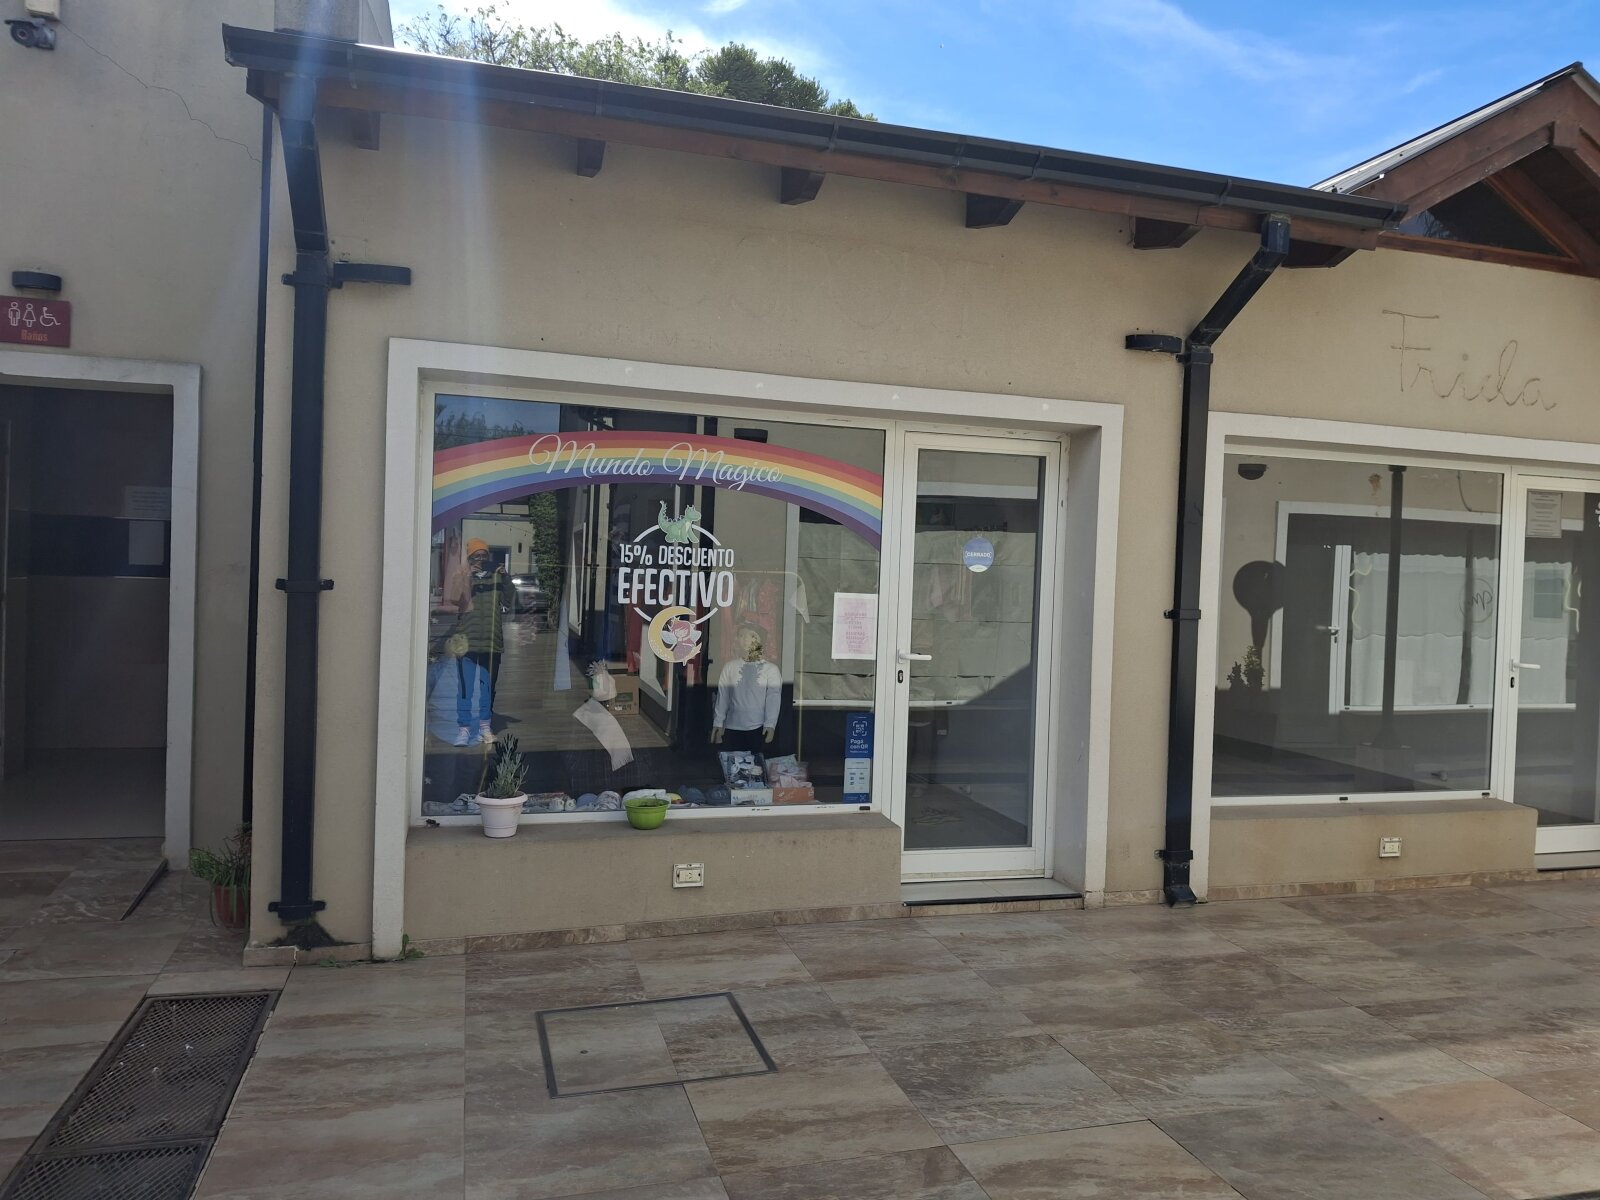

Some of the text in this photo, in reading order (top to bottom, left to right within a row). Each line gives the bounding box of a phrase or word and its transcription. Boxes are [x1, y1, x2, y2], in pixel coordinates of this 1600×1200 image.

[1382, 309, 1557, 411] Frida
[528, 434, 784, 491] Mundo Magico
[619, 543, 735, 568] 15% DESCUENTO
[617, 567, 734, 608] EFECTIVO
